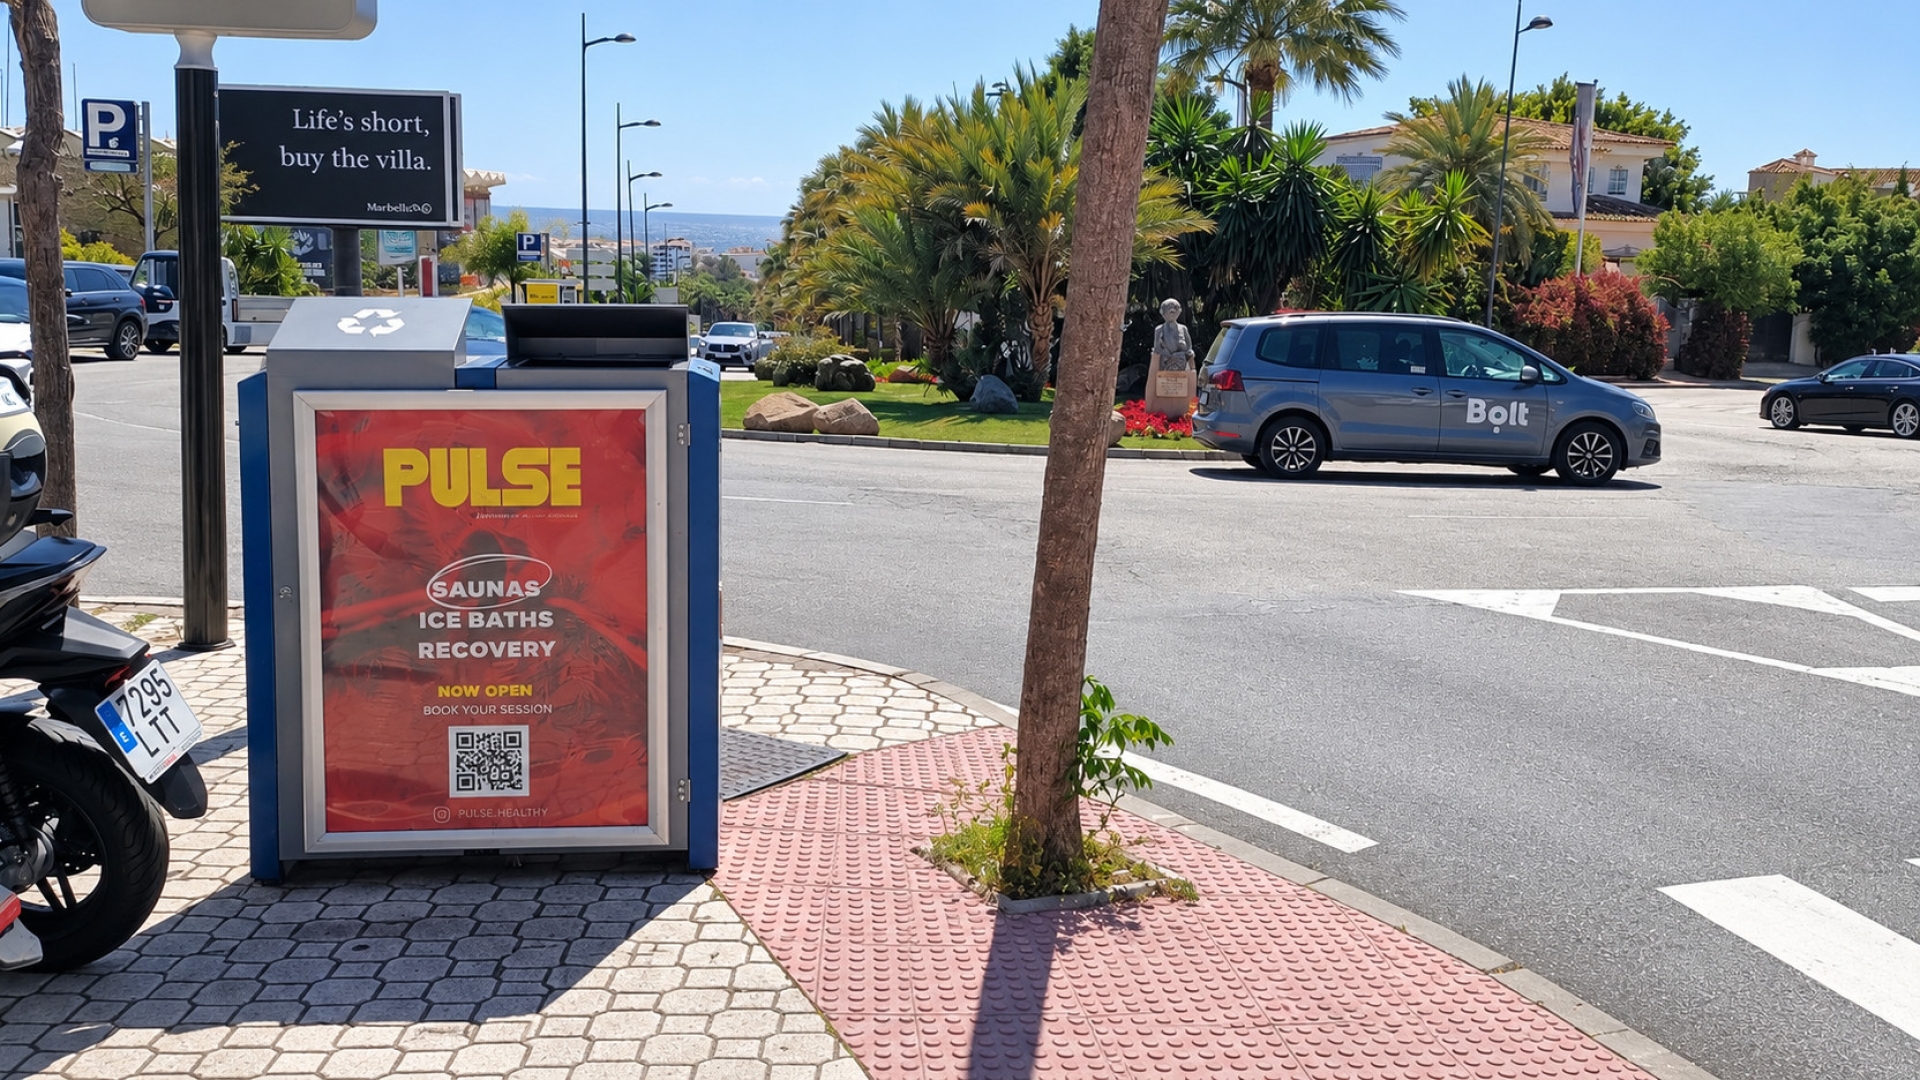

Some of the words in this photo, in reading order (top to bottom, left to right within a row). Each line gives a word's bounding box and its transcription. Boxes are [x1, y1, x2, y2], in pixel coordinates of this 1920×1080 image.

[87, 102, 127, 148] P
[361, 111, 430, 137] short,
[279, 145, 325, 174] buy
[332, 147, 370, 168] the
[376, 149, 432, 171] villa.
[523, 234, 535, 250] P
[1465, 397, 1530, 434] Bolt
[383, 447, 582, 508] PULSE
[431, 580, 541, 598] SAUNAS
[419, 611, 462, 629] ICE
[468, 610, 555, 629] BATHS
[418, 640, 556, 660] RECOVERY
[115, 667, 172, 727] 7295
[437, 684, 480, 698] NOW
[484, 684, 533, 698] OPEN
[423, 704, 459, 716] BOOK
[461, 704, 497, 715] YOUR
[500, 703, 553, 715] SESSION
[134, 705, 181, 758] LTT
[457, 807, 549, 819] PULSE.HEALTHY
